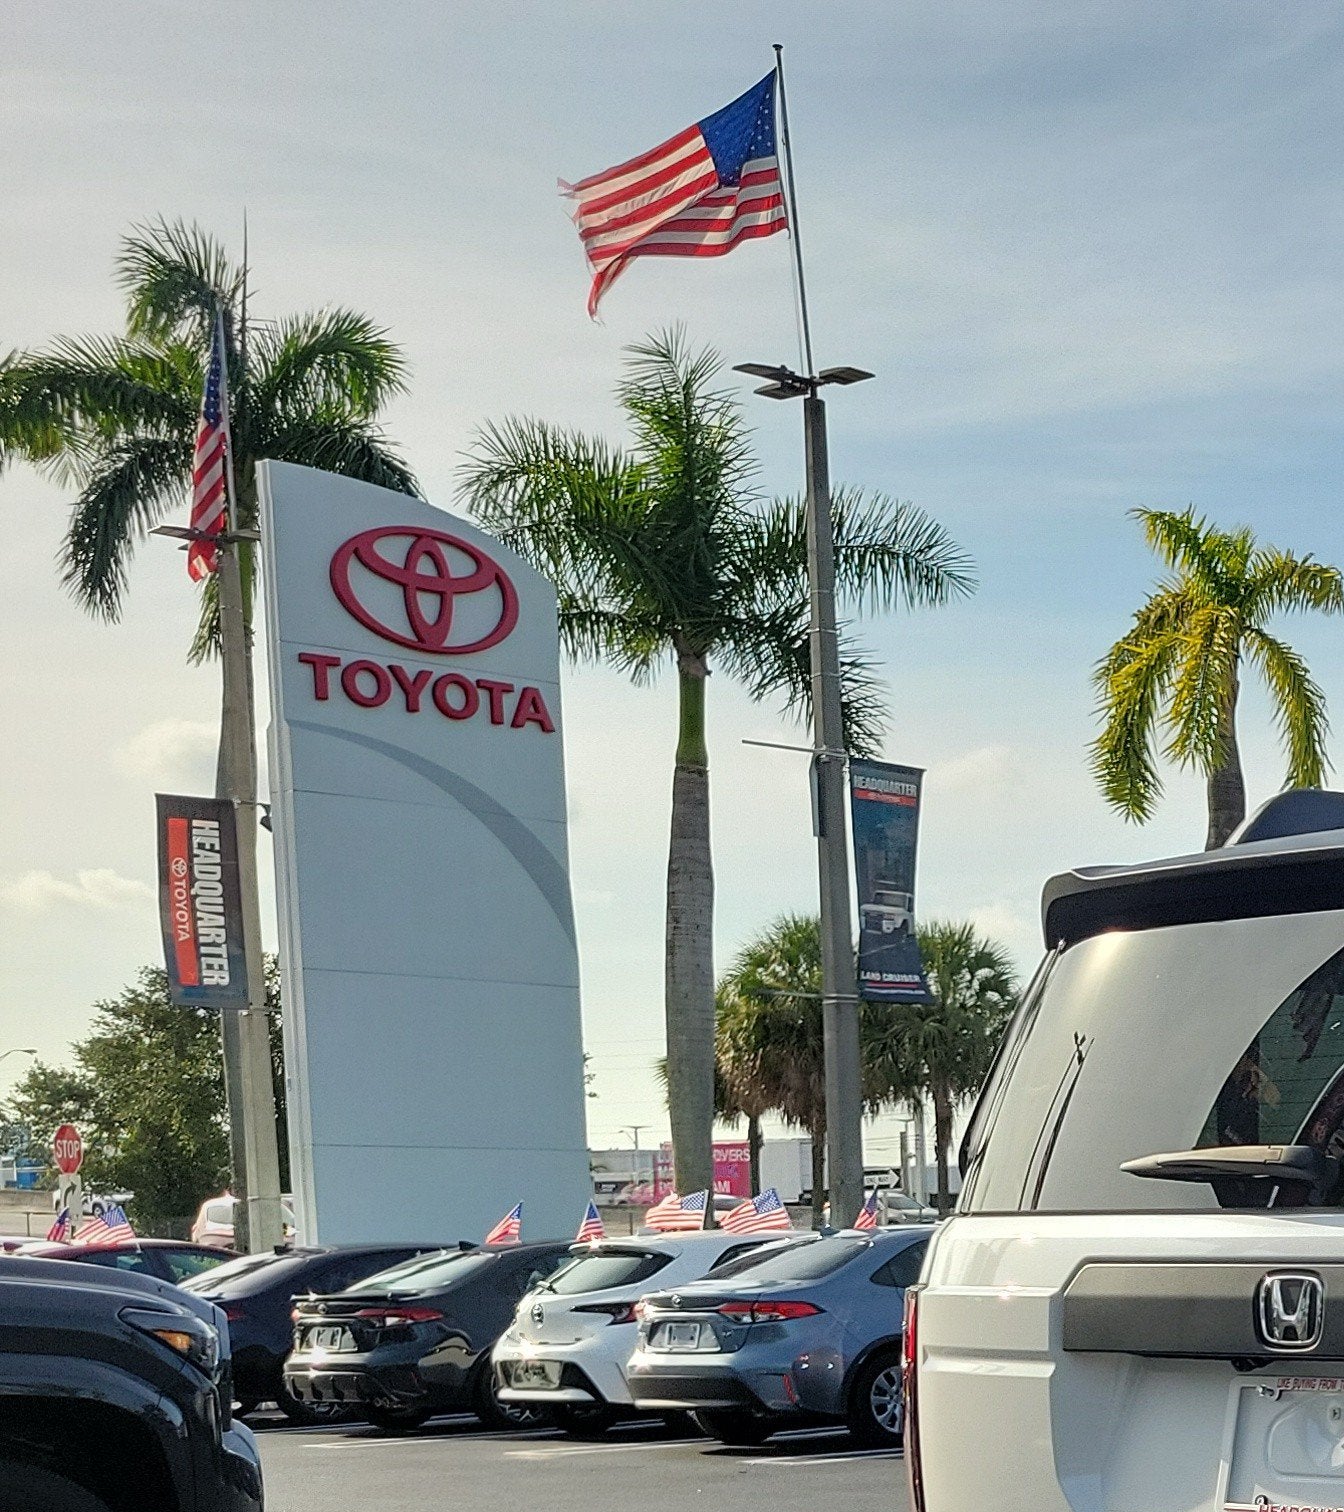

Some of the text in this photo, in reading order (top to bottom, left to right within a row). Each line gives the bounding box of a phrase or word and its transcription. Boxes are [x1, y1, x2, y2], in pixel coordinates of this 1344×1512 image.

[298, 652, 556, 733] TOYOTA
[173, 879, 191, 942] TOYOTA
[191, 819, 230, 986] HEADQUARTER
[56, 1140, 81, 1159] STOP
[1318, 1378, 1337, 1390] FROM
